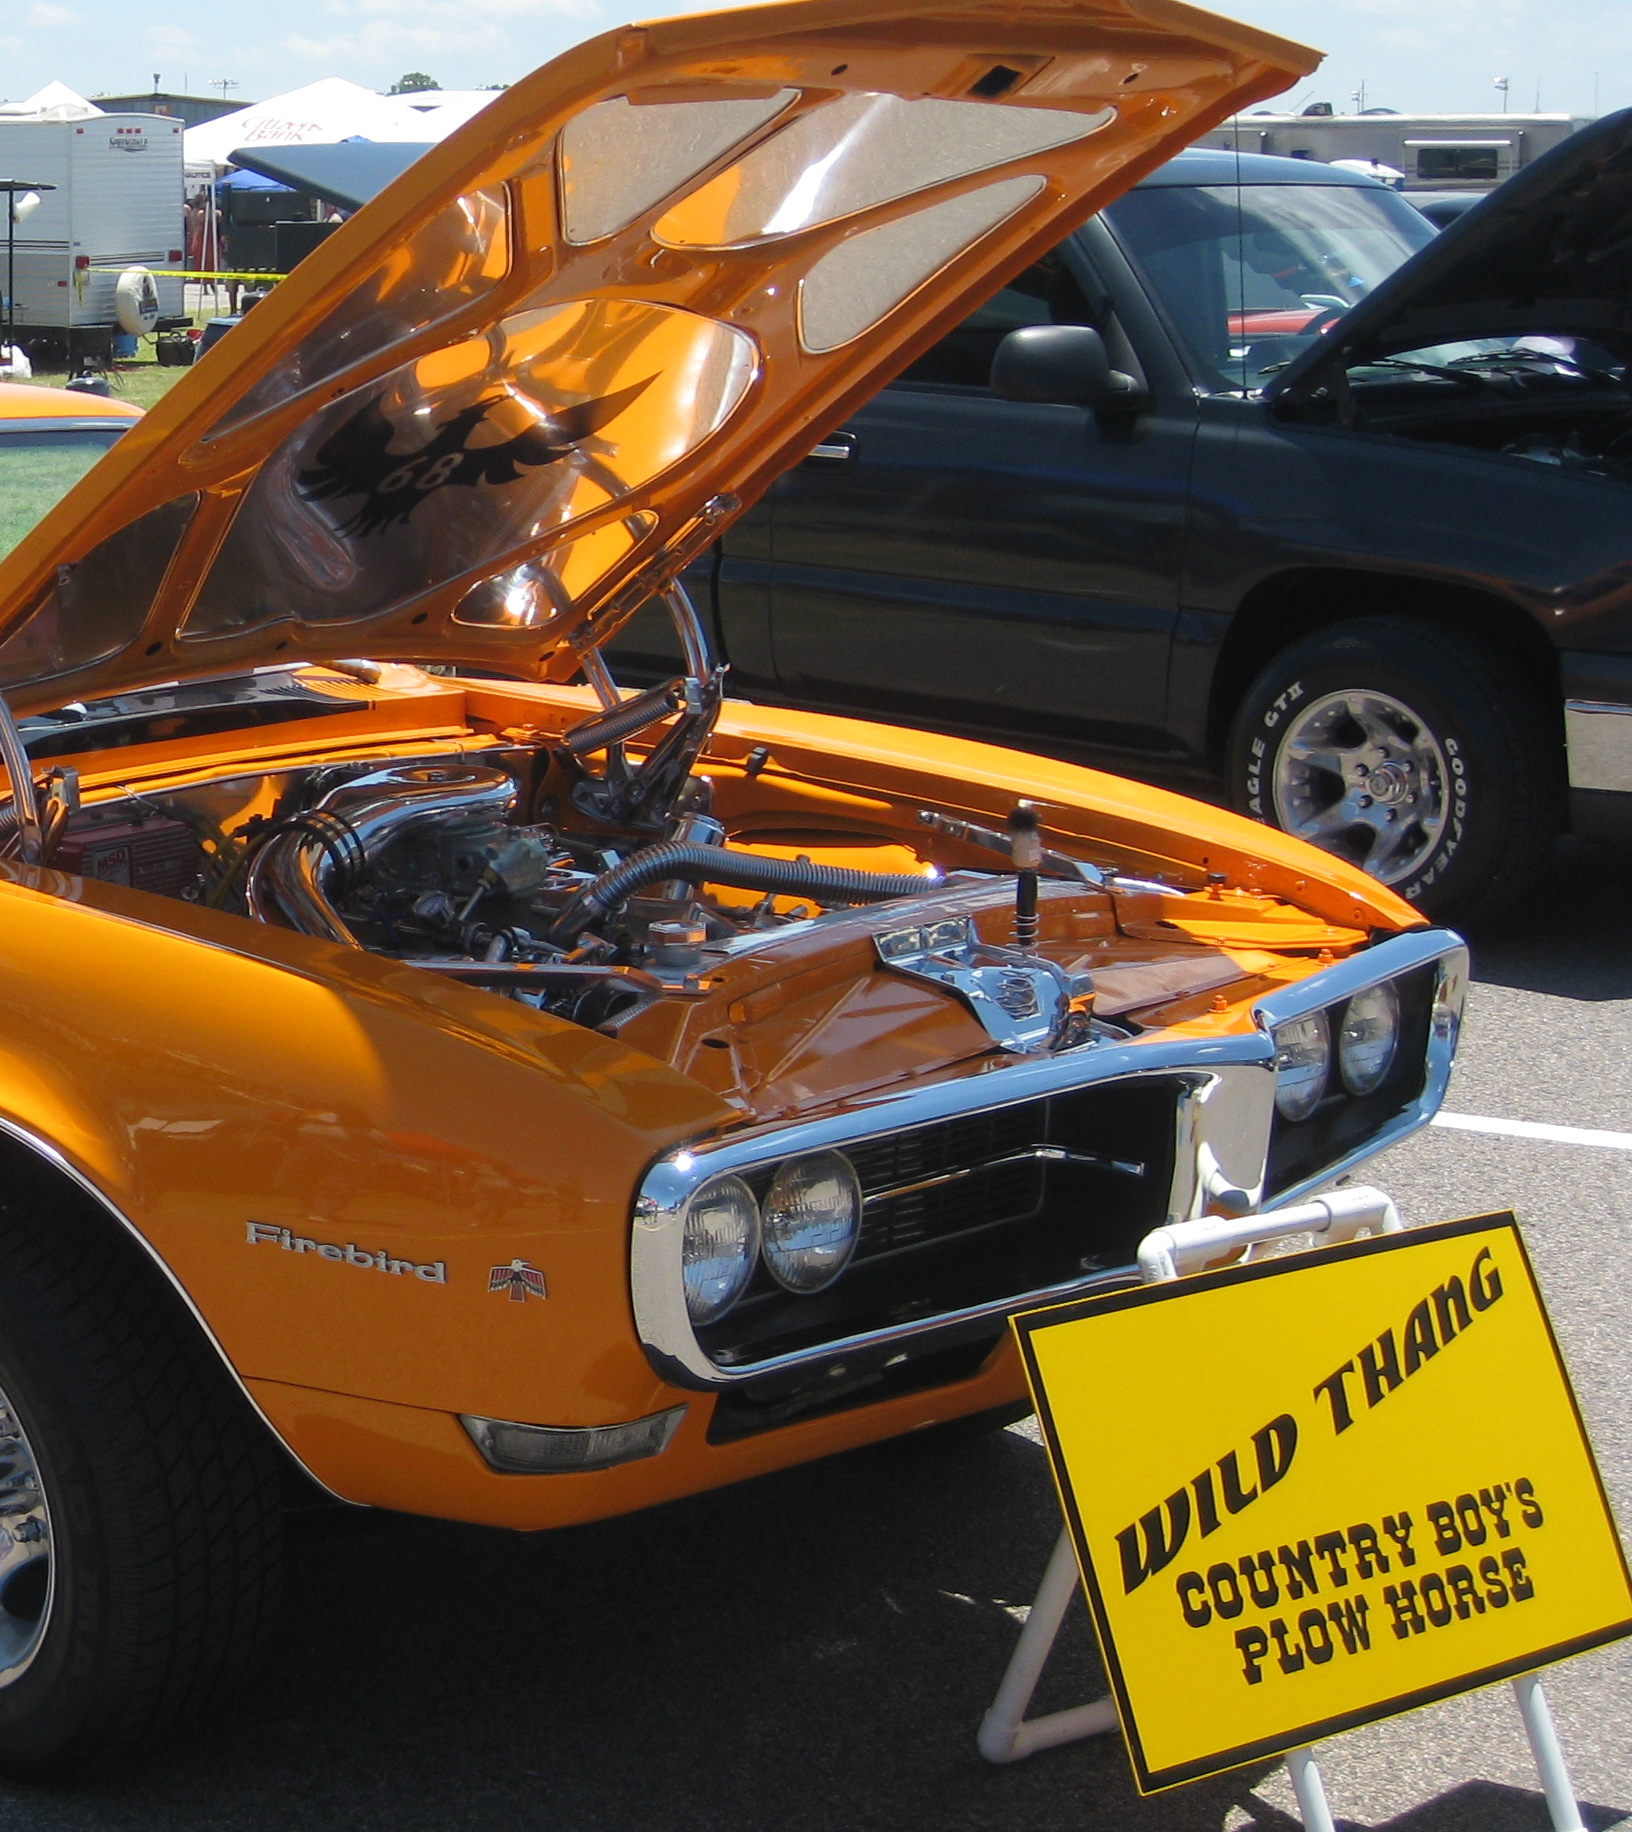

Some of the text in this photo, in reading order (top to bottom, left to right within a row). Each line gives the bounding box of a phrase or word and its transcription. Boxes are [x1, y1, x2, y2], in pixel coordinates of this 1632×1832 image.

[376, 452, 464, 493] 68
[1246, 737, 1266, 822] AGLE
[1405, 737, 1467, 900] GOODYEAR
[97, 849, 126, 872] MSD
[245, 1220, 448, 1285] Firebird
[1114, 1245, 1504, 1596] WILD THANG
[1176, 1477, 1544, 1628] COUNTRY BOY'S
[1234, 1547, 1535, 1686] PLOW HORSE
